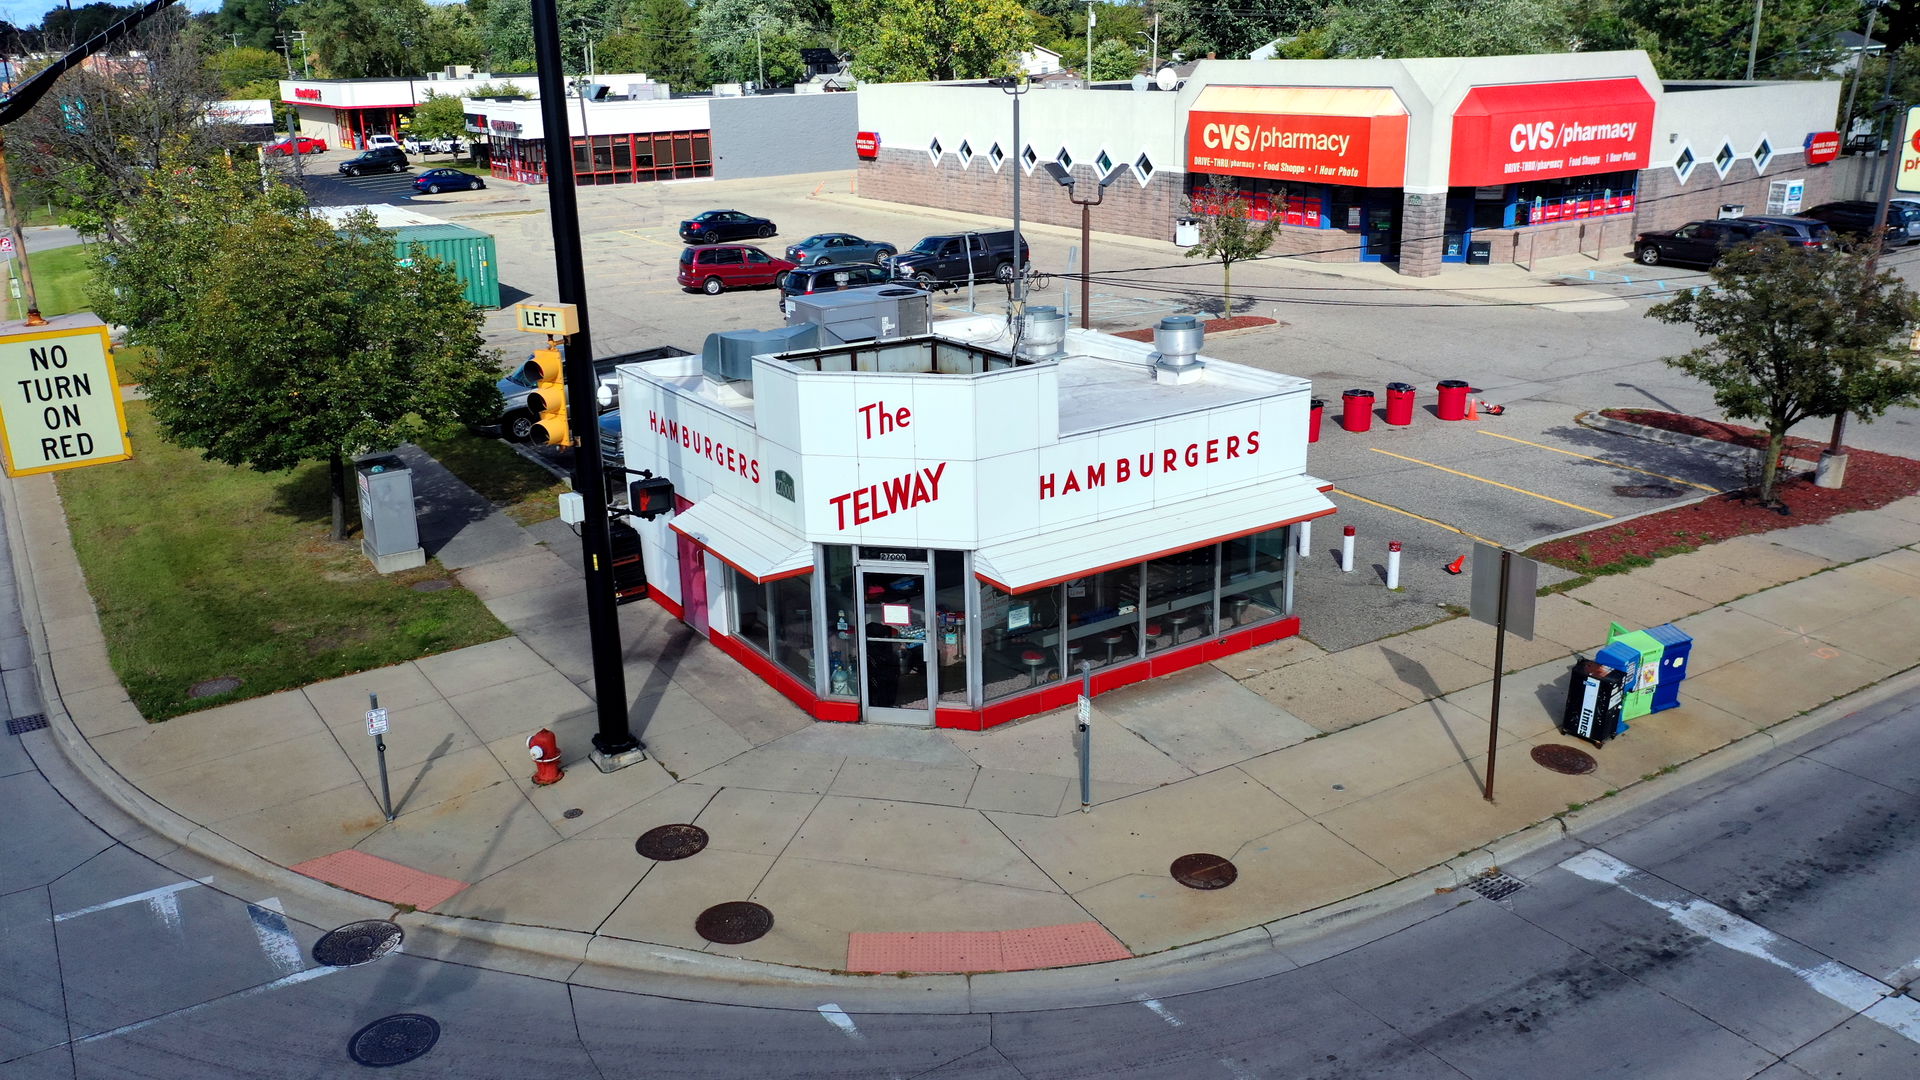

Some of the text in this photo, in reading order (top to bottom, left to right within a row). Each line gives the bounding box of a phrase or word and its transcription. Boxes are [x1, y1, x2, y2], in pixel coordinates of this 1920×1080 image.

[1264, 161, 1279, 171] Food
[1281, 162, 1305, 174] Shoppe
[1320, 166, 1335, 176] Hour
[1338, 166, 1358, 178] Photo
[1568, 157, 1581, 167] Food
[1582, 155, 1600, 167] Shoppe
[1609, 153, 1622, 162] Hour
[1622, 151, 1636, 161] Photo
[525, 311, 556, 328] LEFT
[30, 345, 68, 371] NO
[18, 373, 91, 403] TURN
[44, 404, 81, 430] ON
[858, 400, 911, 439] The
[41, 433, 94, 460] RED
[649, 410, 760, 484] HAMBURGERS
[1039, 430, 1259, 500] HAMBURGERS
[829, 462, 946, 531] TELWAY
[1579, 707, 1593, 737] times
